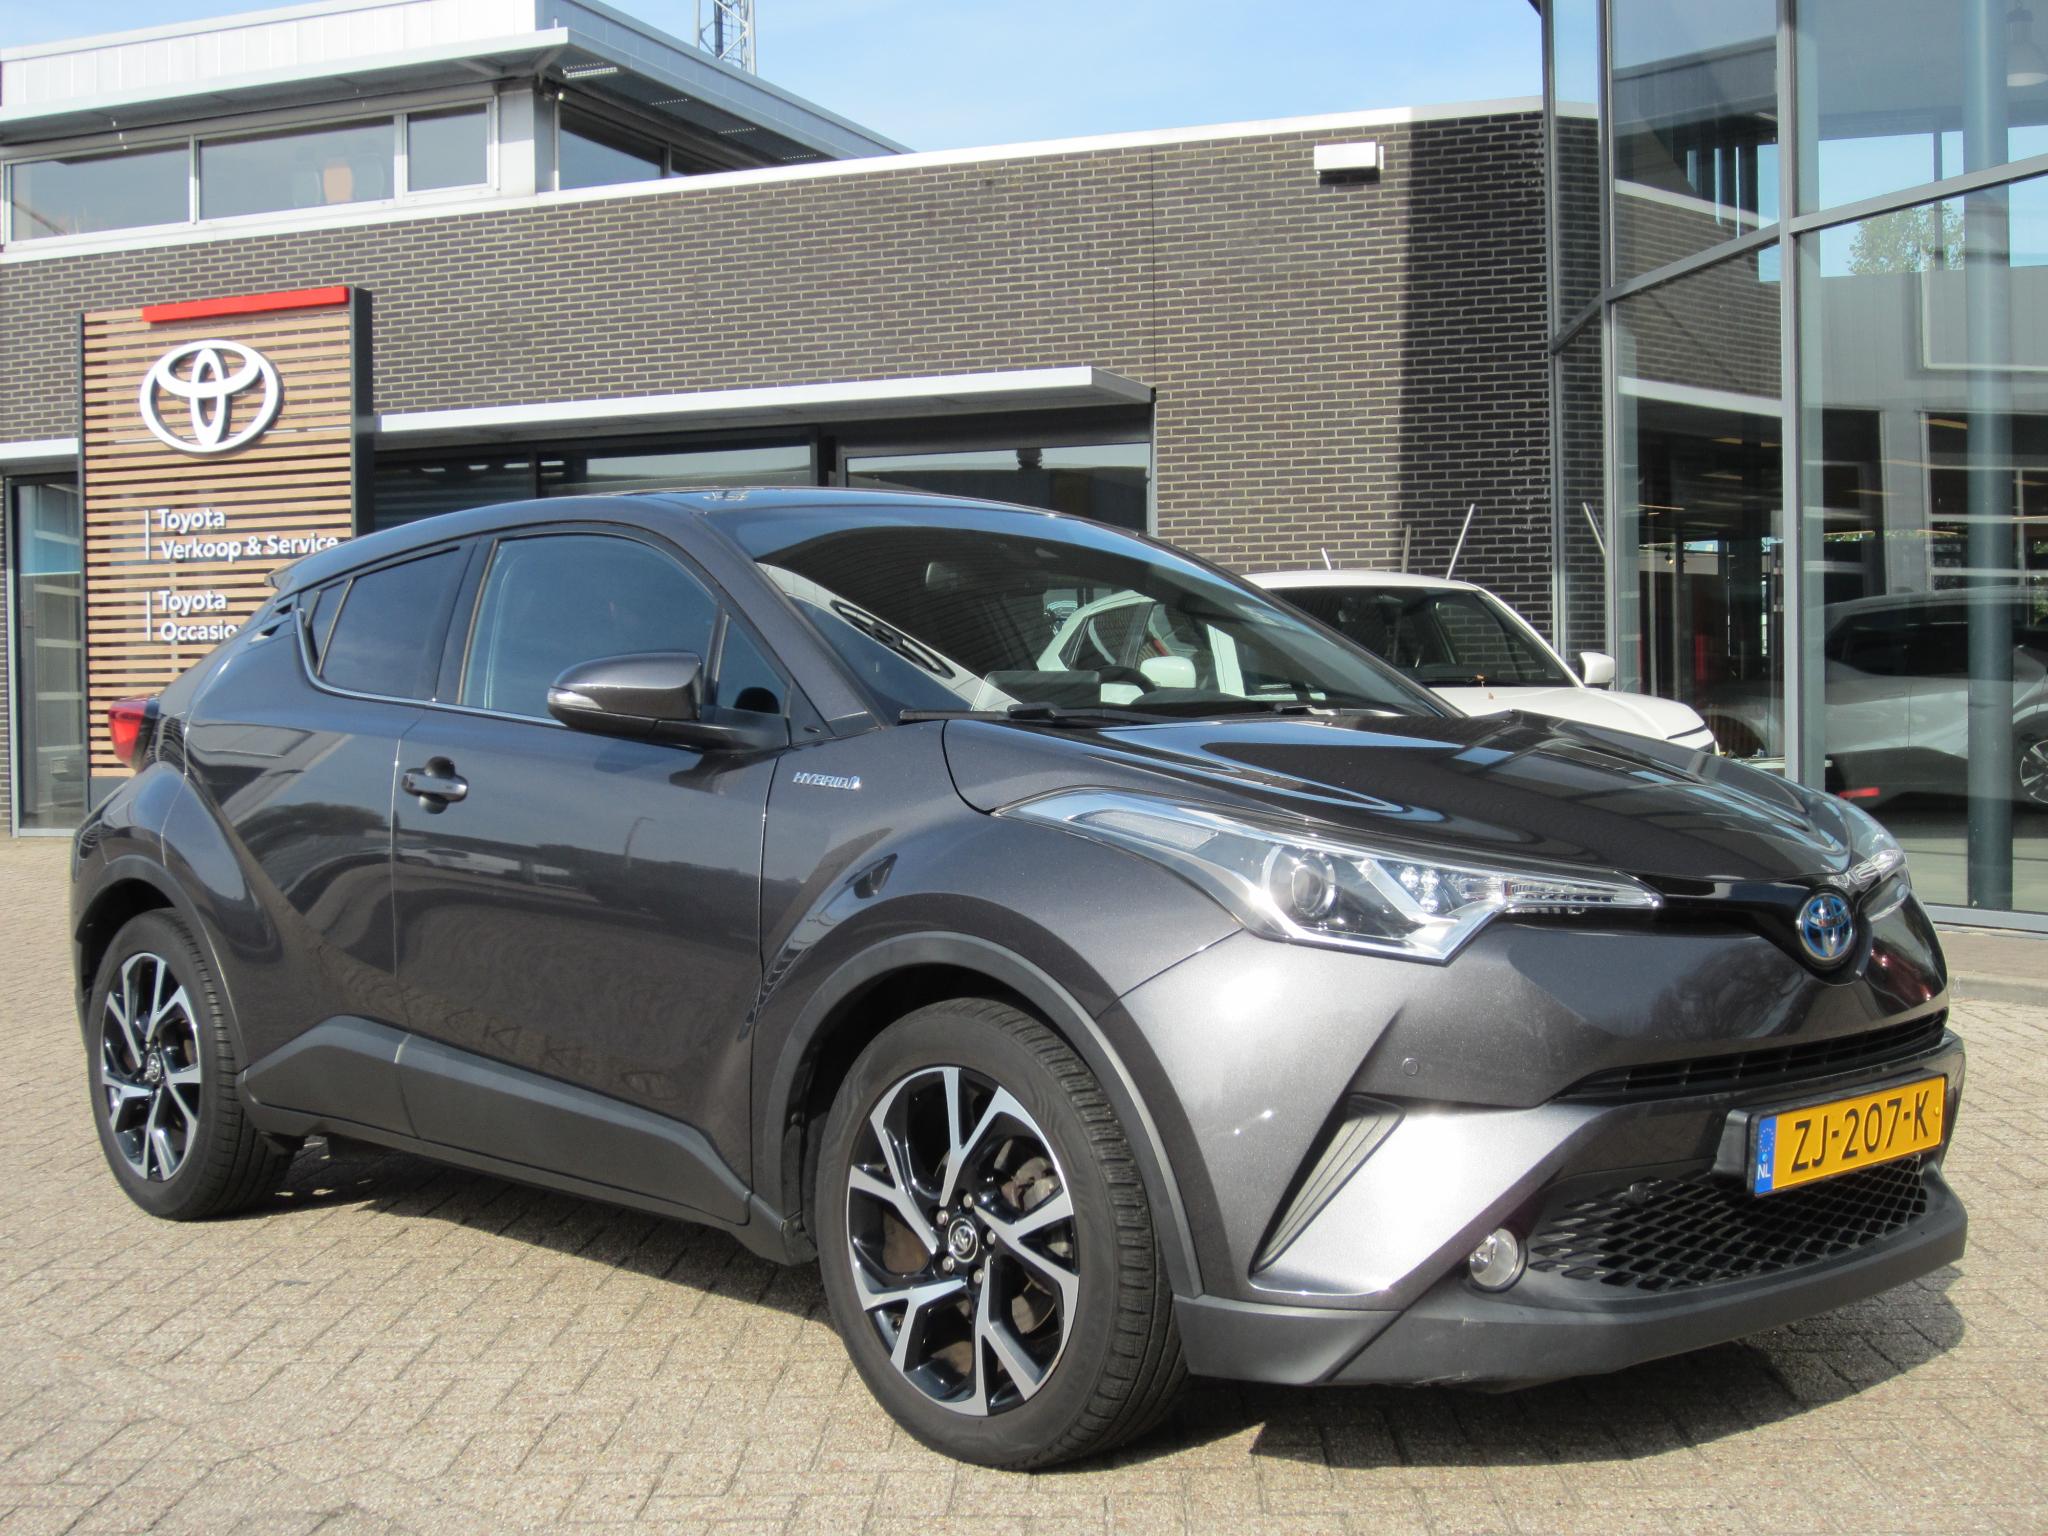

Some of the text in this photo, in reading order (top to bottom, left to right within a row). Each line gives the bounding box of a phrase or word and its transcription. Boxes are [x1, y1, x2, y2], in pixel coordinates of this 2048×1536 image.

[157, 508, 226, 534] Toyota
[161, 532, 339, 563] Verkoop & Service
[158, 589, 227, 616] Toyota
[160, 619, 241, 642] Occasio
[792, 771, 850, 790] HYBRID
[1790, 1089, 1930, 1174] ZJ-207-K
[1757, 1163, 1771, 1180] NL
